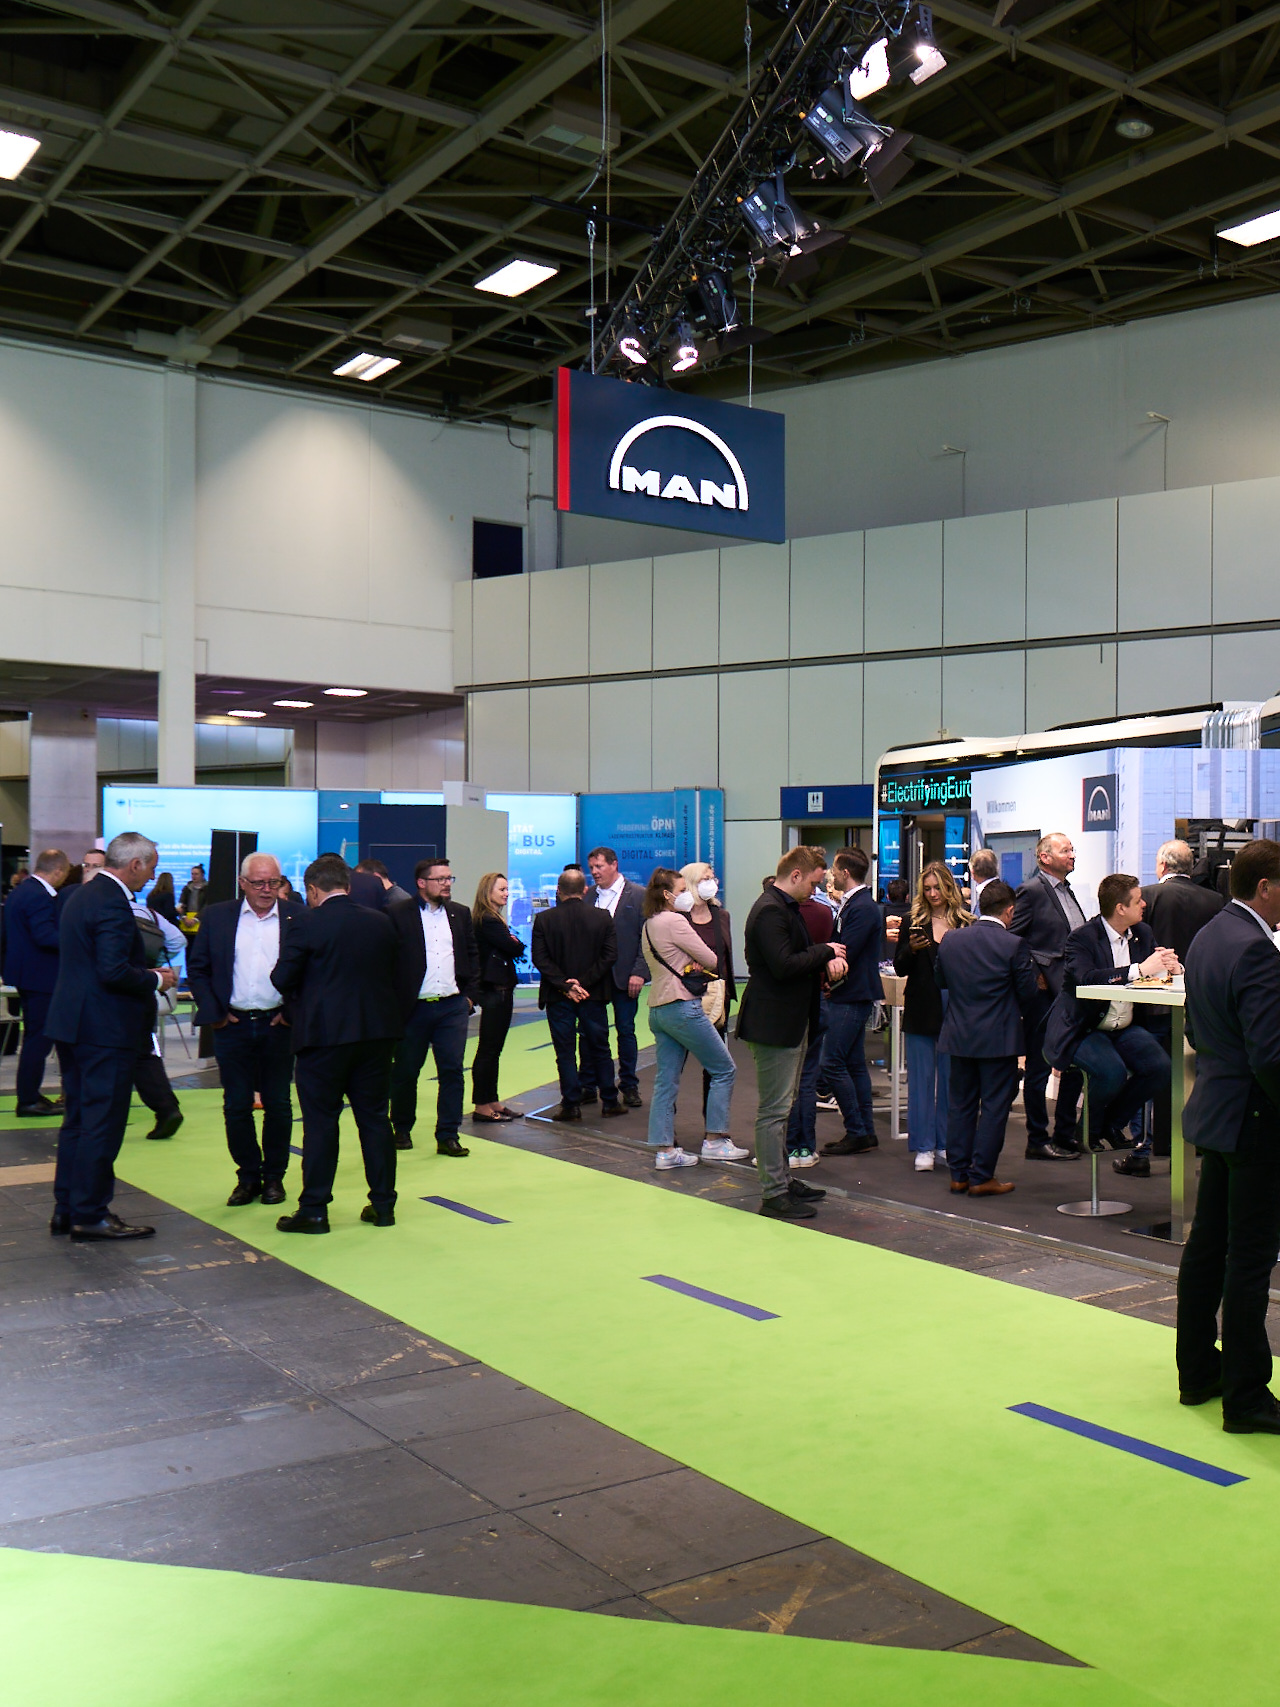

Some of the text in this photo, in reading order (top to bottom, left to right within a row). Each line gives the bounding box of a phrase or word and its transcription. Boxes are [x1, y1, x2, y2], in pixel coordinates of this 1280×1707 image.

[622, 465, 737, 510] MAN
[1088, 809, 1111, 821] MAN
[522, 835, 556, 847] BUS
